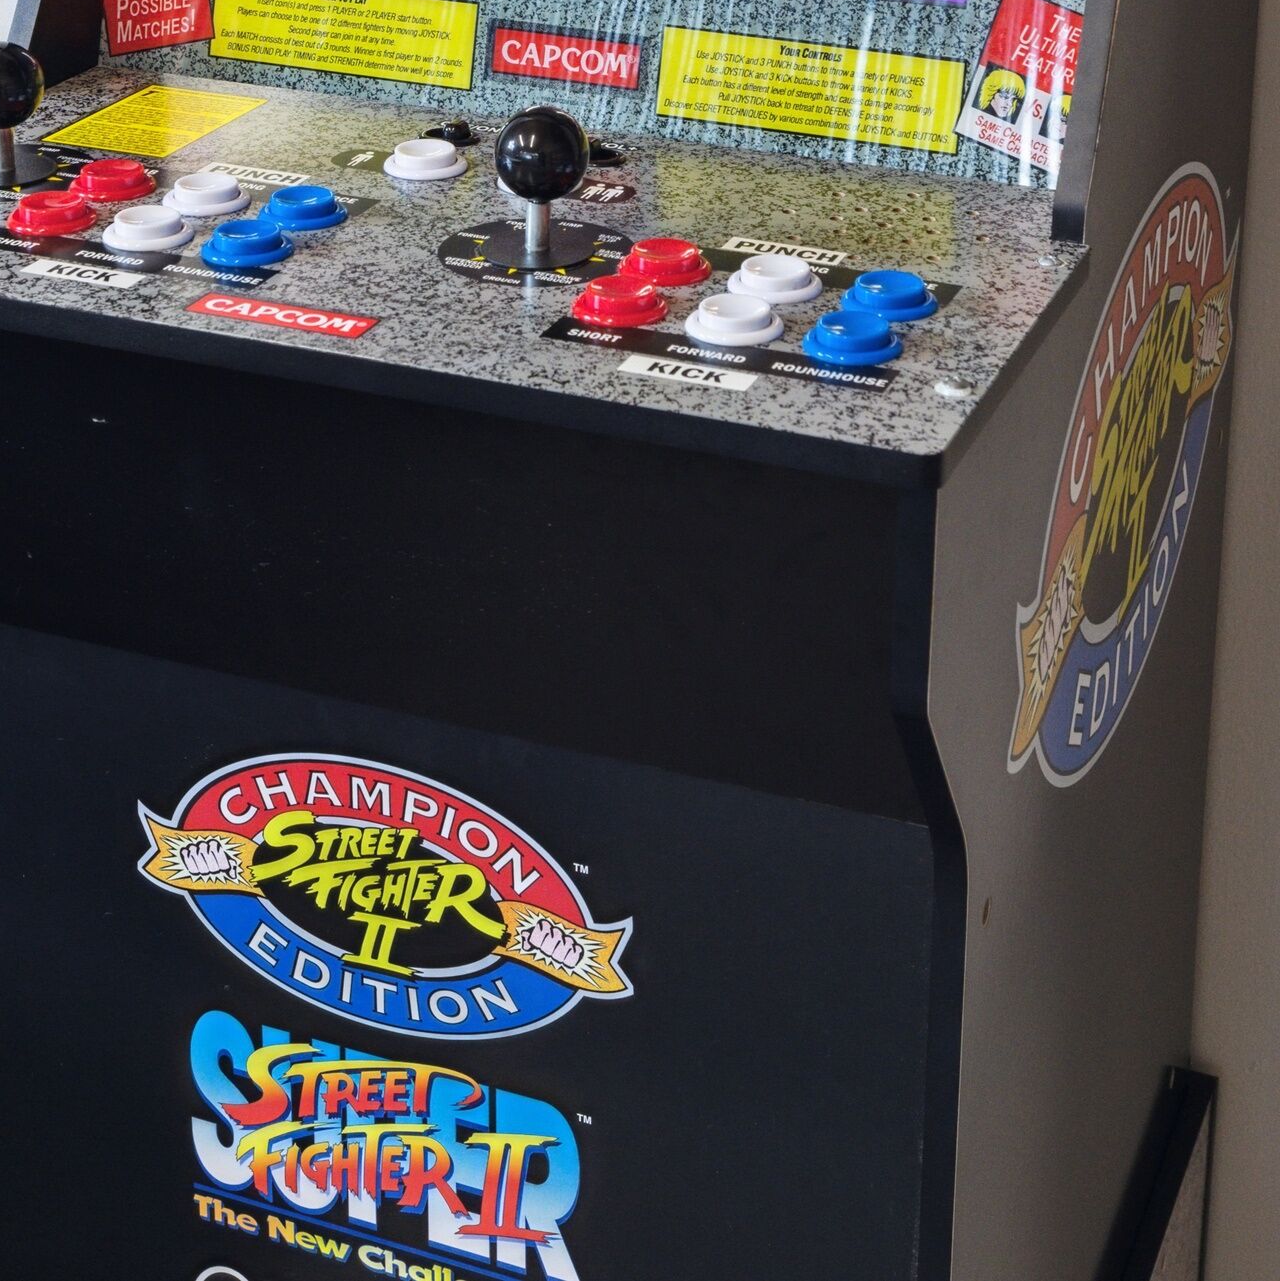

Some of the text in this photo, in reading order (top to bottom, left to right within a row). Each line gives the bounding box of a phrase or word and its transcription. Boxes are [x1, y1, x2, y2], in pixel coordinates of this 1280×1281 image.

[117, 8, 195, 44] MATCHES!
[237, 6, 257, 17] Players
[270, 10, 291, 20] choose
[337, 18, 361, 29] different
[362, 21, 385, 33] fighters
[395, 27, 417, 37] moving
[308, 4, 325, 13] press
[332, 5, 356, 15] PLAYER
[371, 10, 395, 20] PLAYER
[397, 13, 410, 22] start
[287, 25, 354, 41] Second player join
[1049, 14, 1082, 43] THE
[220, 28, 235, 38] Each
[236, 30, 258, 41] MATCH
[259, 33, 285, 44] consists
[353, 45, 375, 55] Winner
[395, 50, 414, 62] player
[227, 42, 250, 52] BONUS
[251, 45, 273, 55] ROUND
[293, 50, 316, 61] TIMING
[329, 55, 364, 67] STRENGTH
[364, 59, 393, 71] determine
[410, 65, 422, 74] well
[779, 45, 842, 62] YOUR CONTROLS
[1020, 25, 1079, 65] ULTIMA
[710, 51, 744, 64] JOYSTICK
[766, 58, 791, 69] PUNCH
[1011, 45, 1076, 86] FEATUR
[683, 74, 698, 84] Each
[699, 76, 721, 87] button
[742, 82, 769, 93] different
[770, 85, 785, 95] level
[795, 89, 823, 102] strength
[776, 73, 792, 83] KICK
[731, 94, 765, 106] JOYSTICK
[766, 98, 782, 108] back
[792, 102, 814, 112] retreat
[663, 98, 692, 110] Discover
[693, 102, 722, 114] SECRET
[722, 106, 768, 120] TECHNIQUES
[779, 115, 803, 125] various
[860, 124, 895, 137] JOYSTICK
[975, 115, 1001, 134] SAME
[978, 128, 1004, 147] SAME
[209, 166, 302, 185] PUNCH
[76, 250, 144, 266] FORWARD
[735, 240, 842, 263] PUNCH
[46, 264, 118, 282] KICK
[163, 264, 263, 286] ROUNDHOUSE
[567, 328, 622, 343] SHORT
[667, 344, 746, 364] FORWARD
[1070, 198, 1213, 504] CHAMPION
[647, 361, 724, 383] KICK
[772, 362, 888, 388] ROUNDHOUSE
[1067, 458, 1189, 749] EDITION
[219, 770, 543, 896] CHAMPION
[252, 811, 422, 895] STREET
[280, 857, 508, 940] FIGHTER
[341, 912, 424, 976] II
[247, 921, 519, 1025] EDITION
[221, 1044, 484, 1126] STREET
[236, 1121, 560, 1244] FIGHTER II
[193, 1193, 466, 1281] The New Chall
